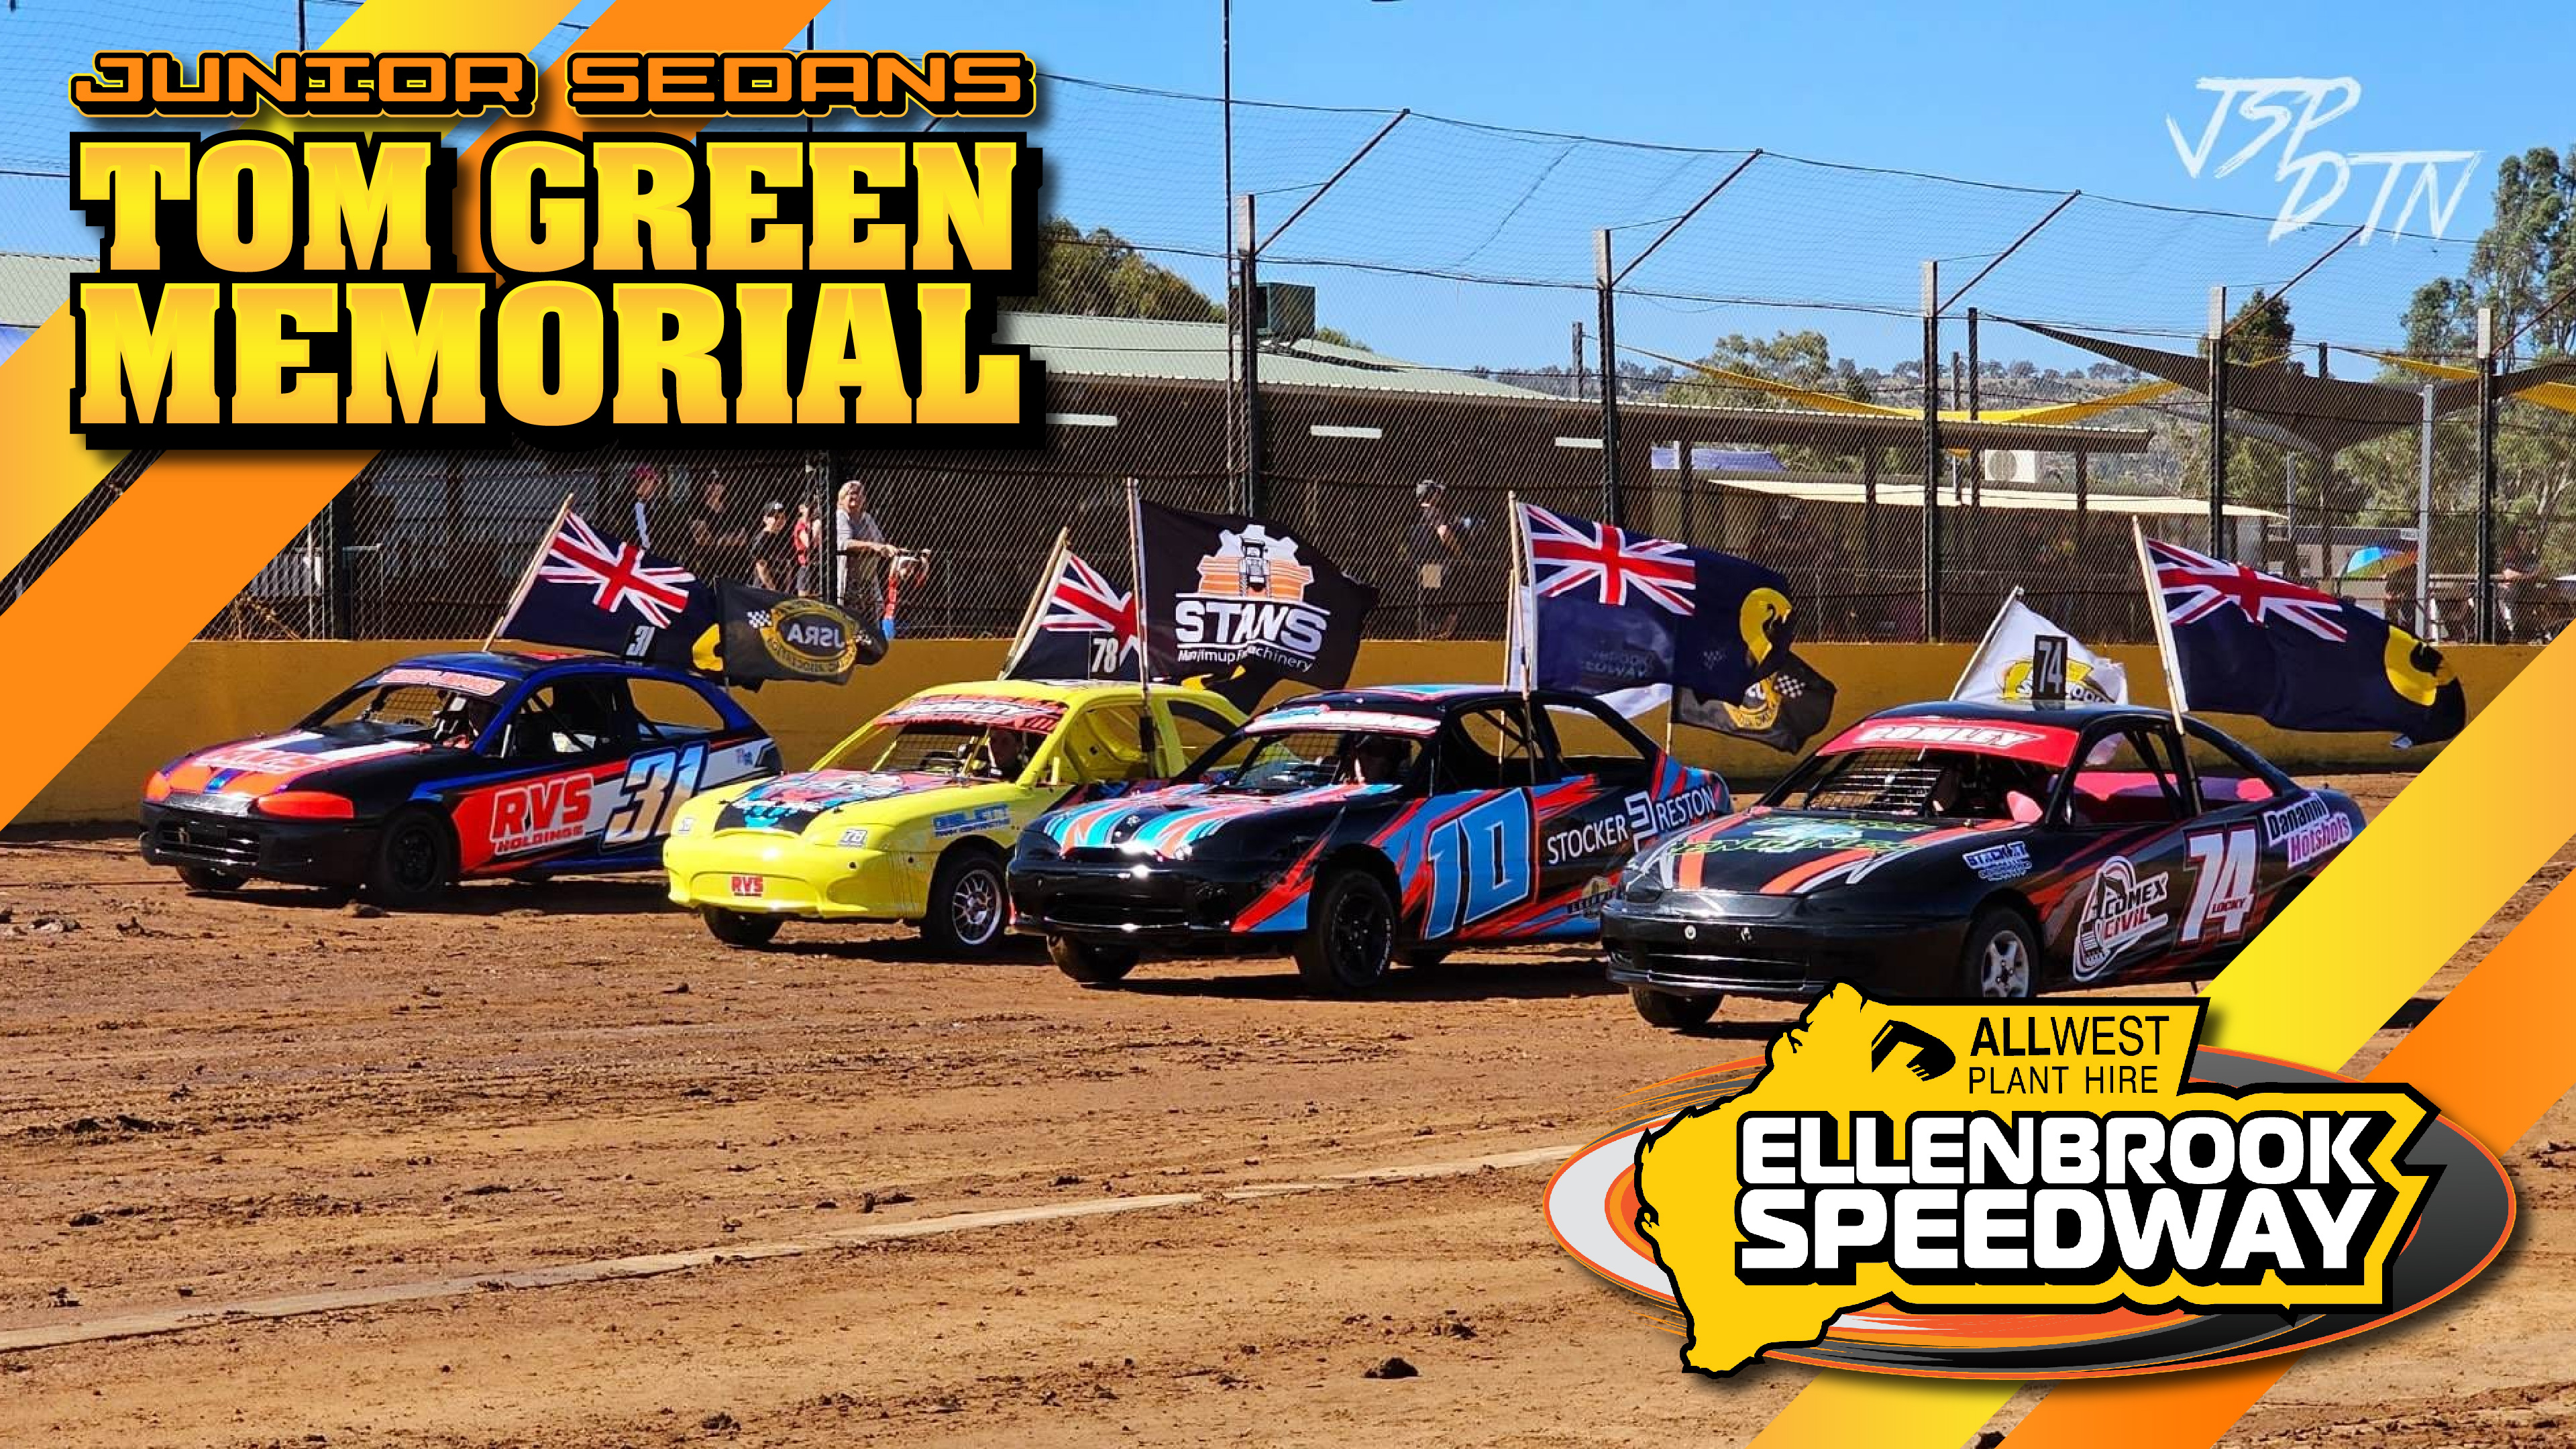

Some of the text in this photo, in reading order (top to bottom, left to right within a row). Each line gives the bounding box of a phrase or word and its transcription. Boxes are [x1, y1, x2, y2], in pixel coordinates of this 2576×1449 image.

[1175, 600, 1327, 653] STANS
[1093, 638, 1119, 672] 78
[2039, 640, 2063, 694] 74
[492, 777, 590, 839] RVS
[604, 743, 707, 844] 31
[1425, 788, 1529, 939] 10
[1547, 814, 1628, 865] STOCKER
[2290, 814, 2351, 863] Hotshots
[731, 876, 763, 892] RVS
[2182, 828, 2255, 941] 74
[2104, 907, 2149, 940] CIVIL
